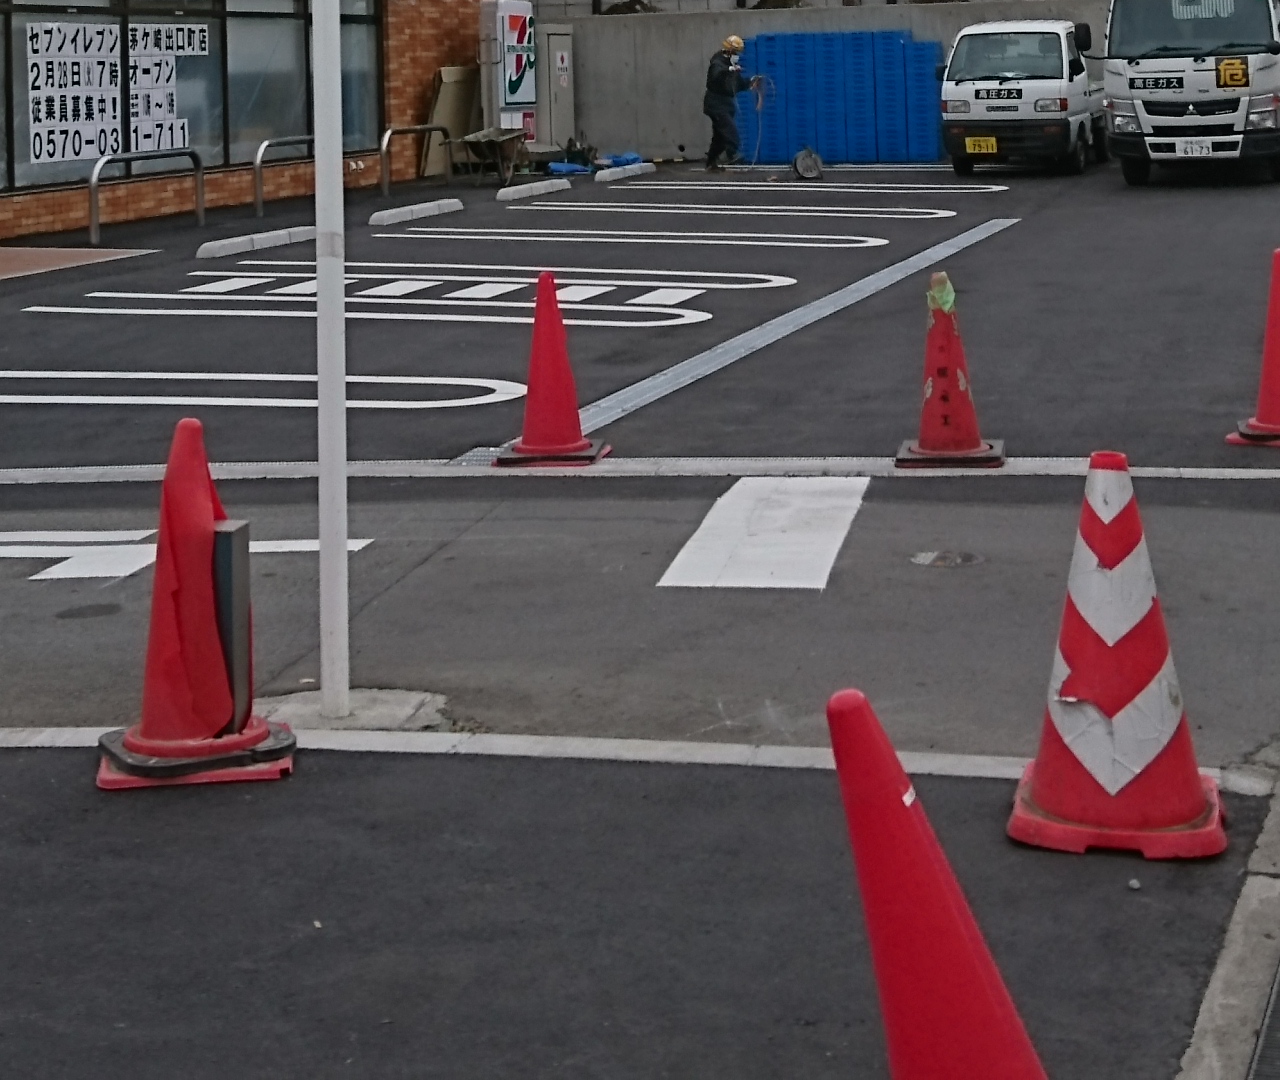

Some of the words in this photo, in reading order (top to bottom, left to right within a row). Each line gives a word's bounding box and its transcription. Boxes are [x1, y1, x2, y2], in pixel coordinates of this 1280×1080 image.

[29, 26, 118, 55] セブンイレブン
[1218, 58, 1247, 86] 危
[1134, 78, 1180, 88] 高圧ガス
[978, 90, 1019, 99] 高圧ガス
